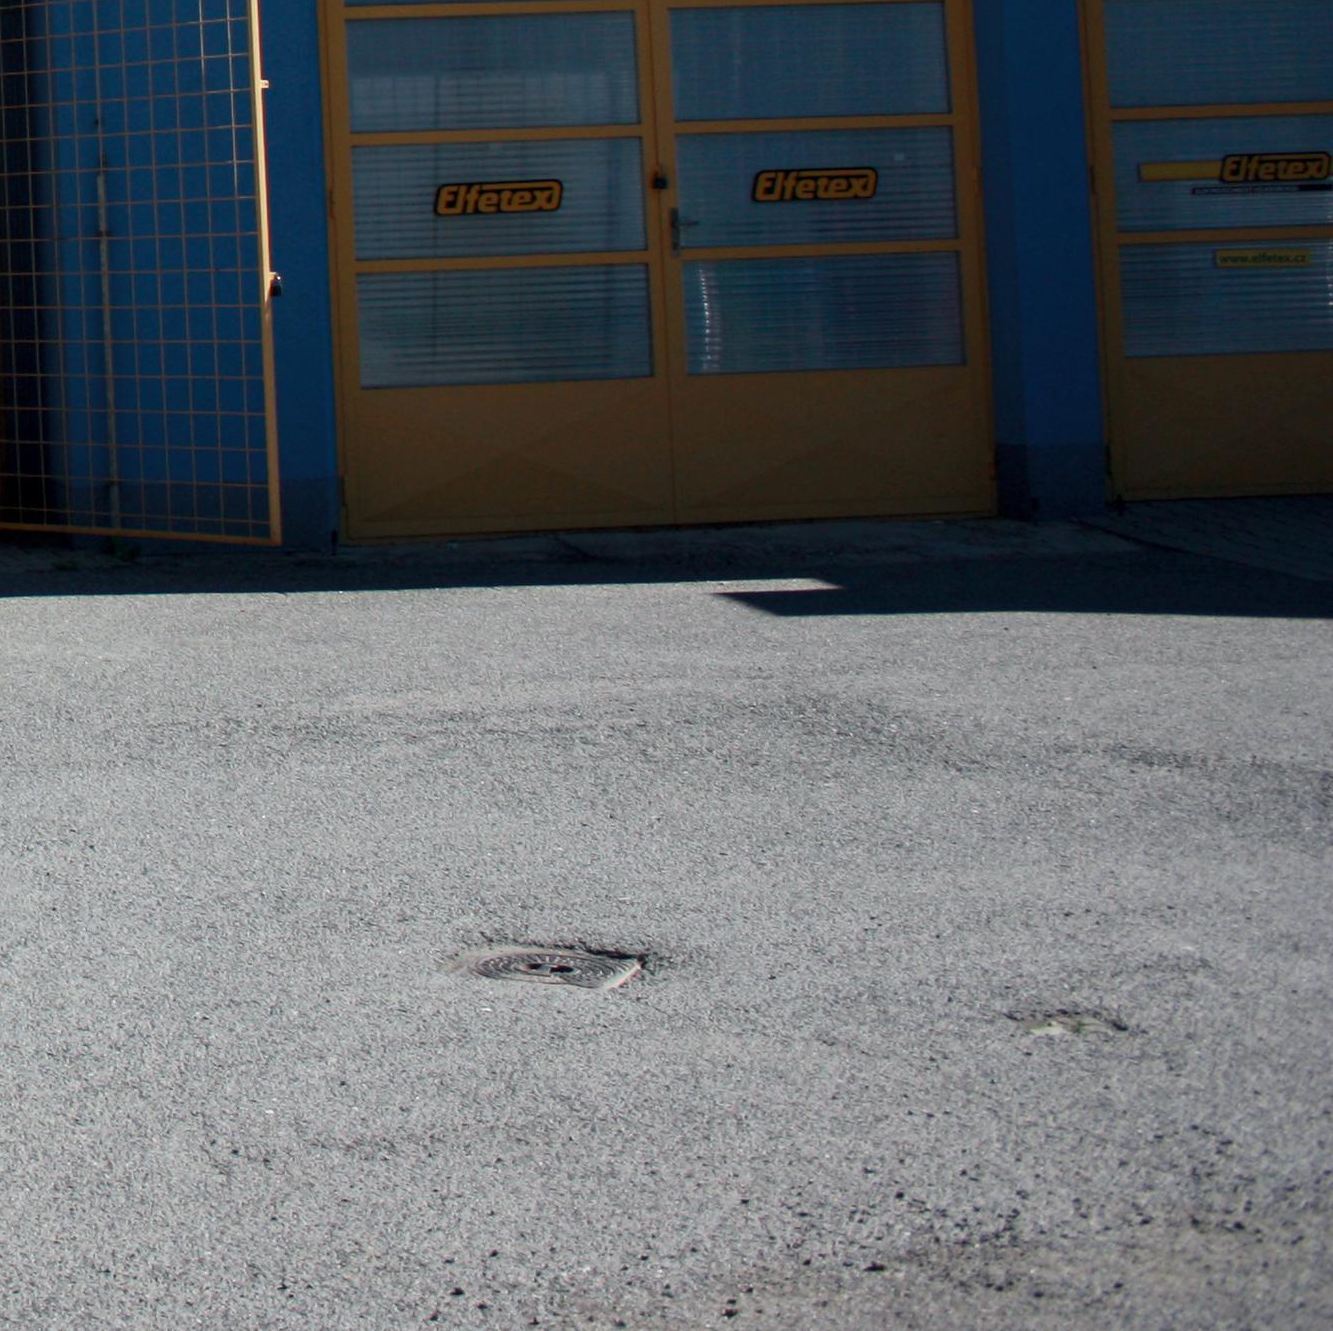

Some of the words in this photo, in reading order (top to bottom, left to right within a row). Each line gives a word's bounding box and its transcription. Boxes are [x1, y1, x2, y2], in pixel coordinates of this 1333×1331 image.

[1222, 153, 1331, 182] Elfetex
[436, 180, 562, 216] Elfetex
[755, 169, 878, 202] Elfetex
[1219, 251, 1307, 264] www.elfetex.cz
